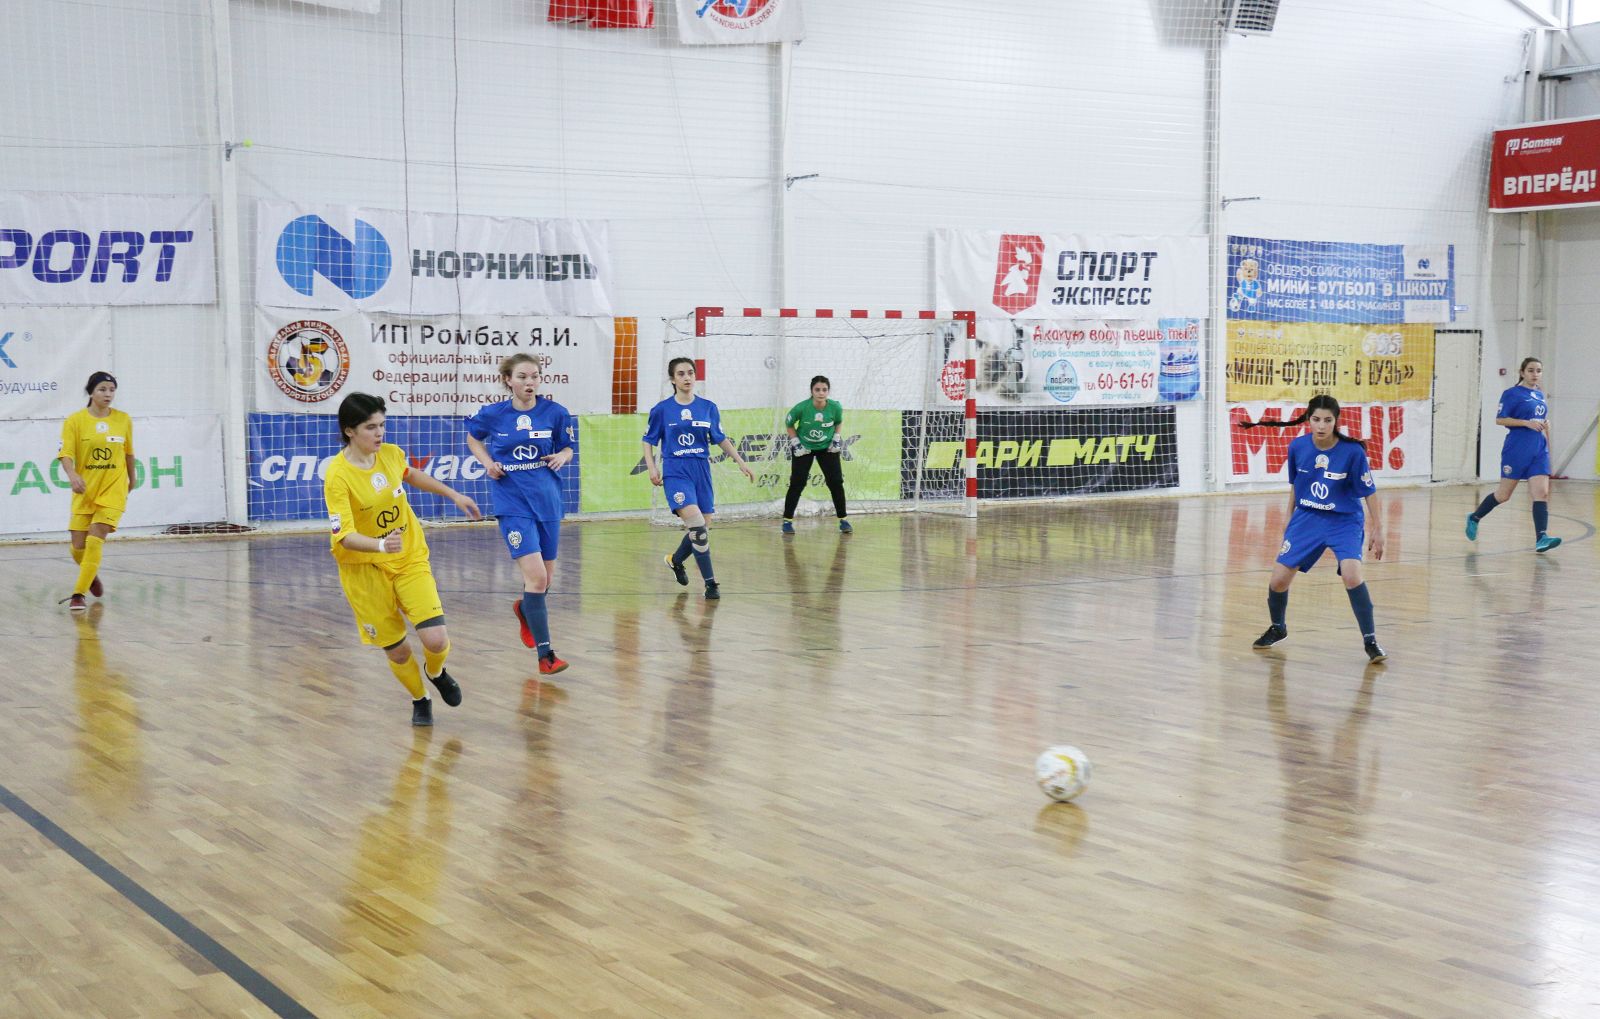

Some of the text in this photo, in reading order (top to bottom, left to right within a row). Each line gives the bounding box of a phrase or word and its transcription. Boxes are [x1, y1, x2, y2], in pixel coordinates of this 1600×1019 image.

[1503, 166, 1597, 196] ВПЕРЁД!
[412, 249, 598, 282] НОРНИЕЛЬ
[1057, 250, 1158, 282] СПОРТ
[1051, 287, 1152, 306] ЭКСПРЕСС
[1383, 282, 1393, 297] В
[1396, 281, 1447, 297] ШКОЛУ
[371, 323, 578, 347] ИП Ромбах Я.И.
[1089, 324, 1119, 348] воду
[1124, 329, 1164, 341] пьешь
[388, 351, 491, 368] официальный
[373, 369, 458, 387] Федерации
